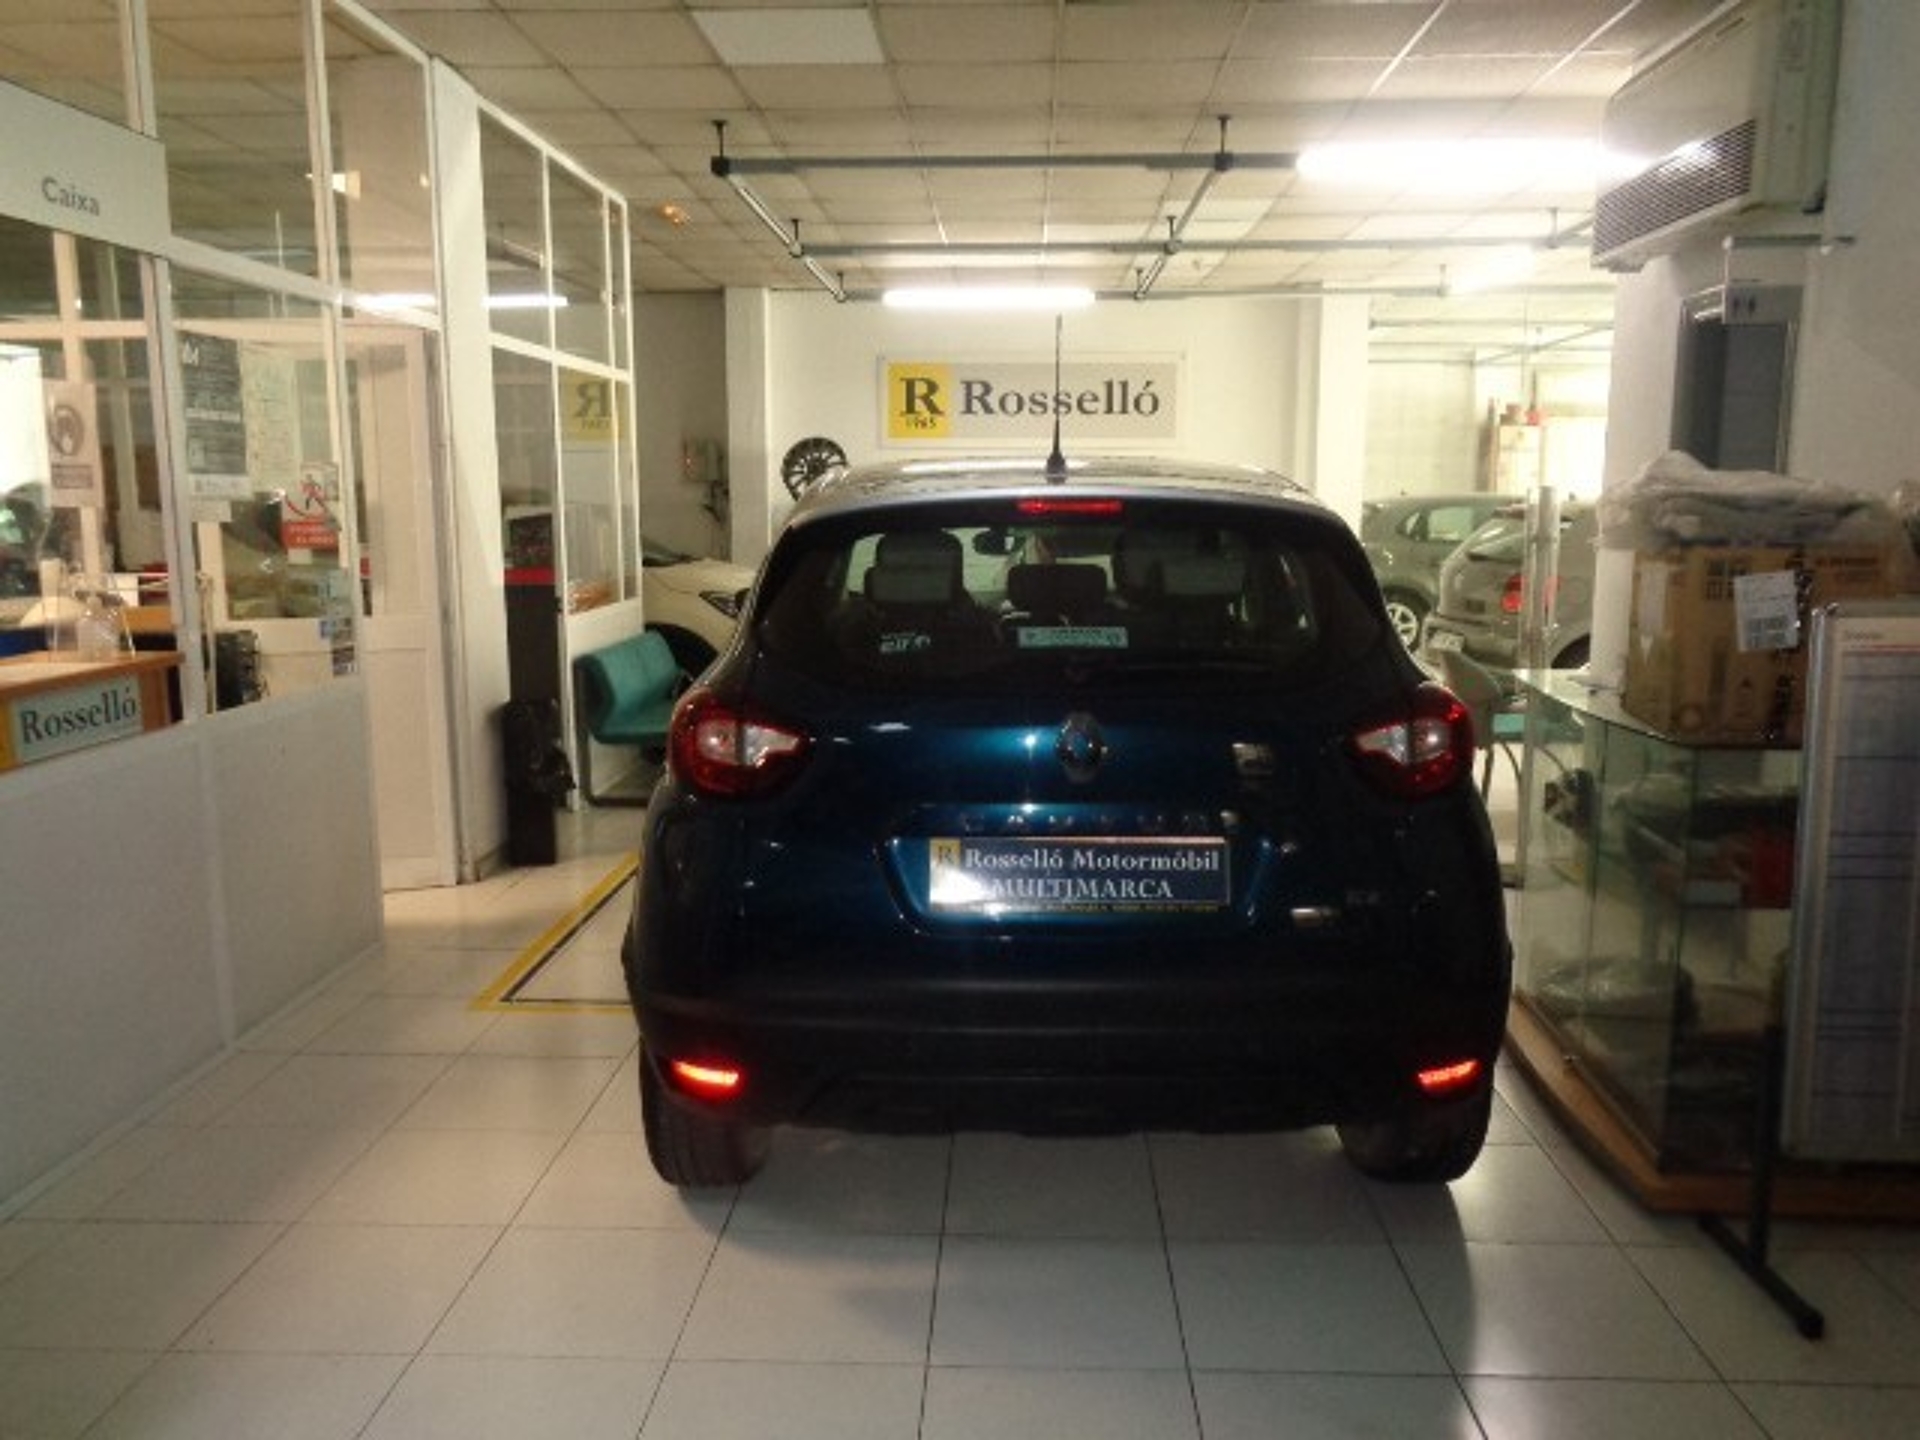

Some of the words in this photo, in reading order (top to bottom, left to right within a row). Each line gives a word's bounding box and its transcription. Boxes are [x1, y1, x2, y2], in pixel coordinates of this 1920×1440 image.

[40, 176, 101, 217] Caixa
[900, 376, 945, 417] R
[960, 379, 1160, 416] Rosselló
[19, 687, 138, 745] Rosselló
[965, 848, 1063, 869] Rosselló
[1073, 848, 1220, 871] Motormóbil
[990, 878, 1173, 900] MULTIMARCA
